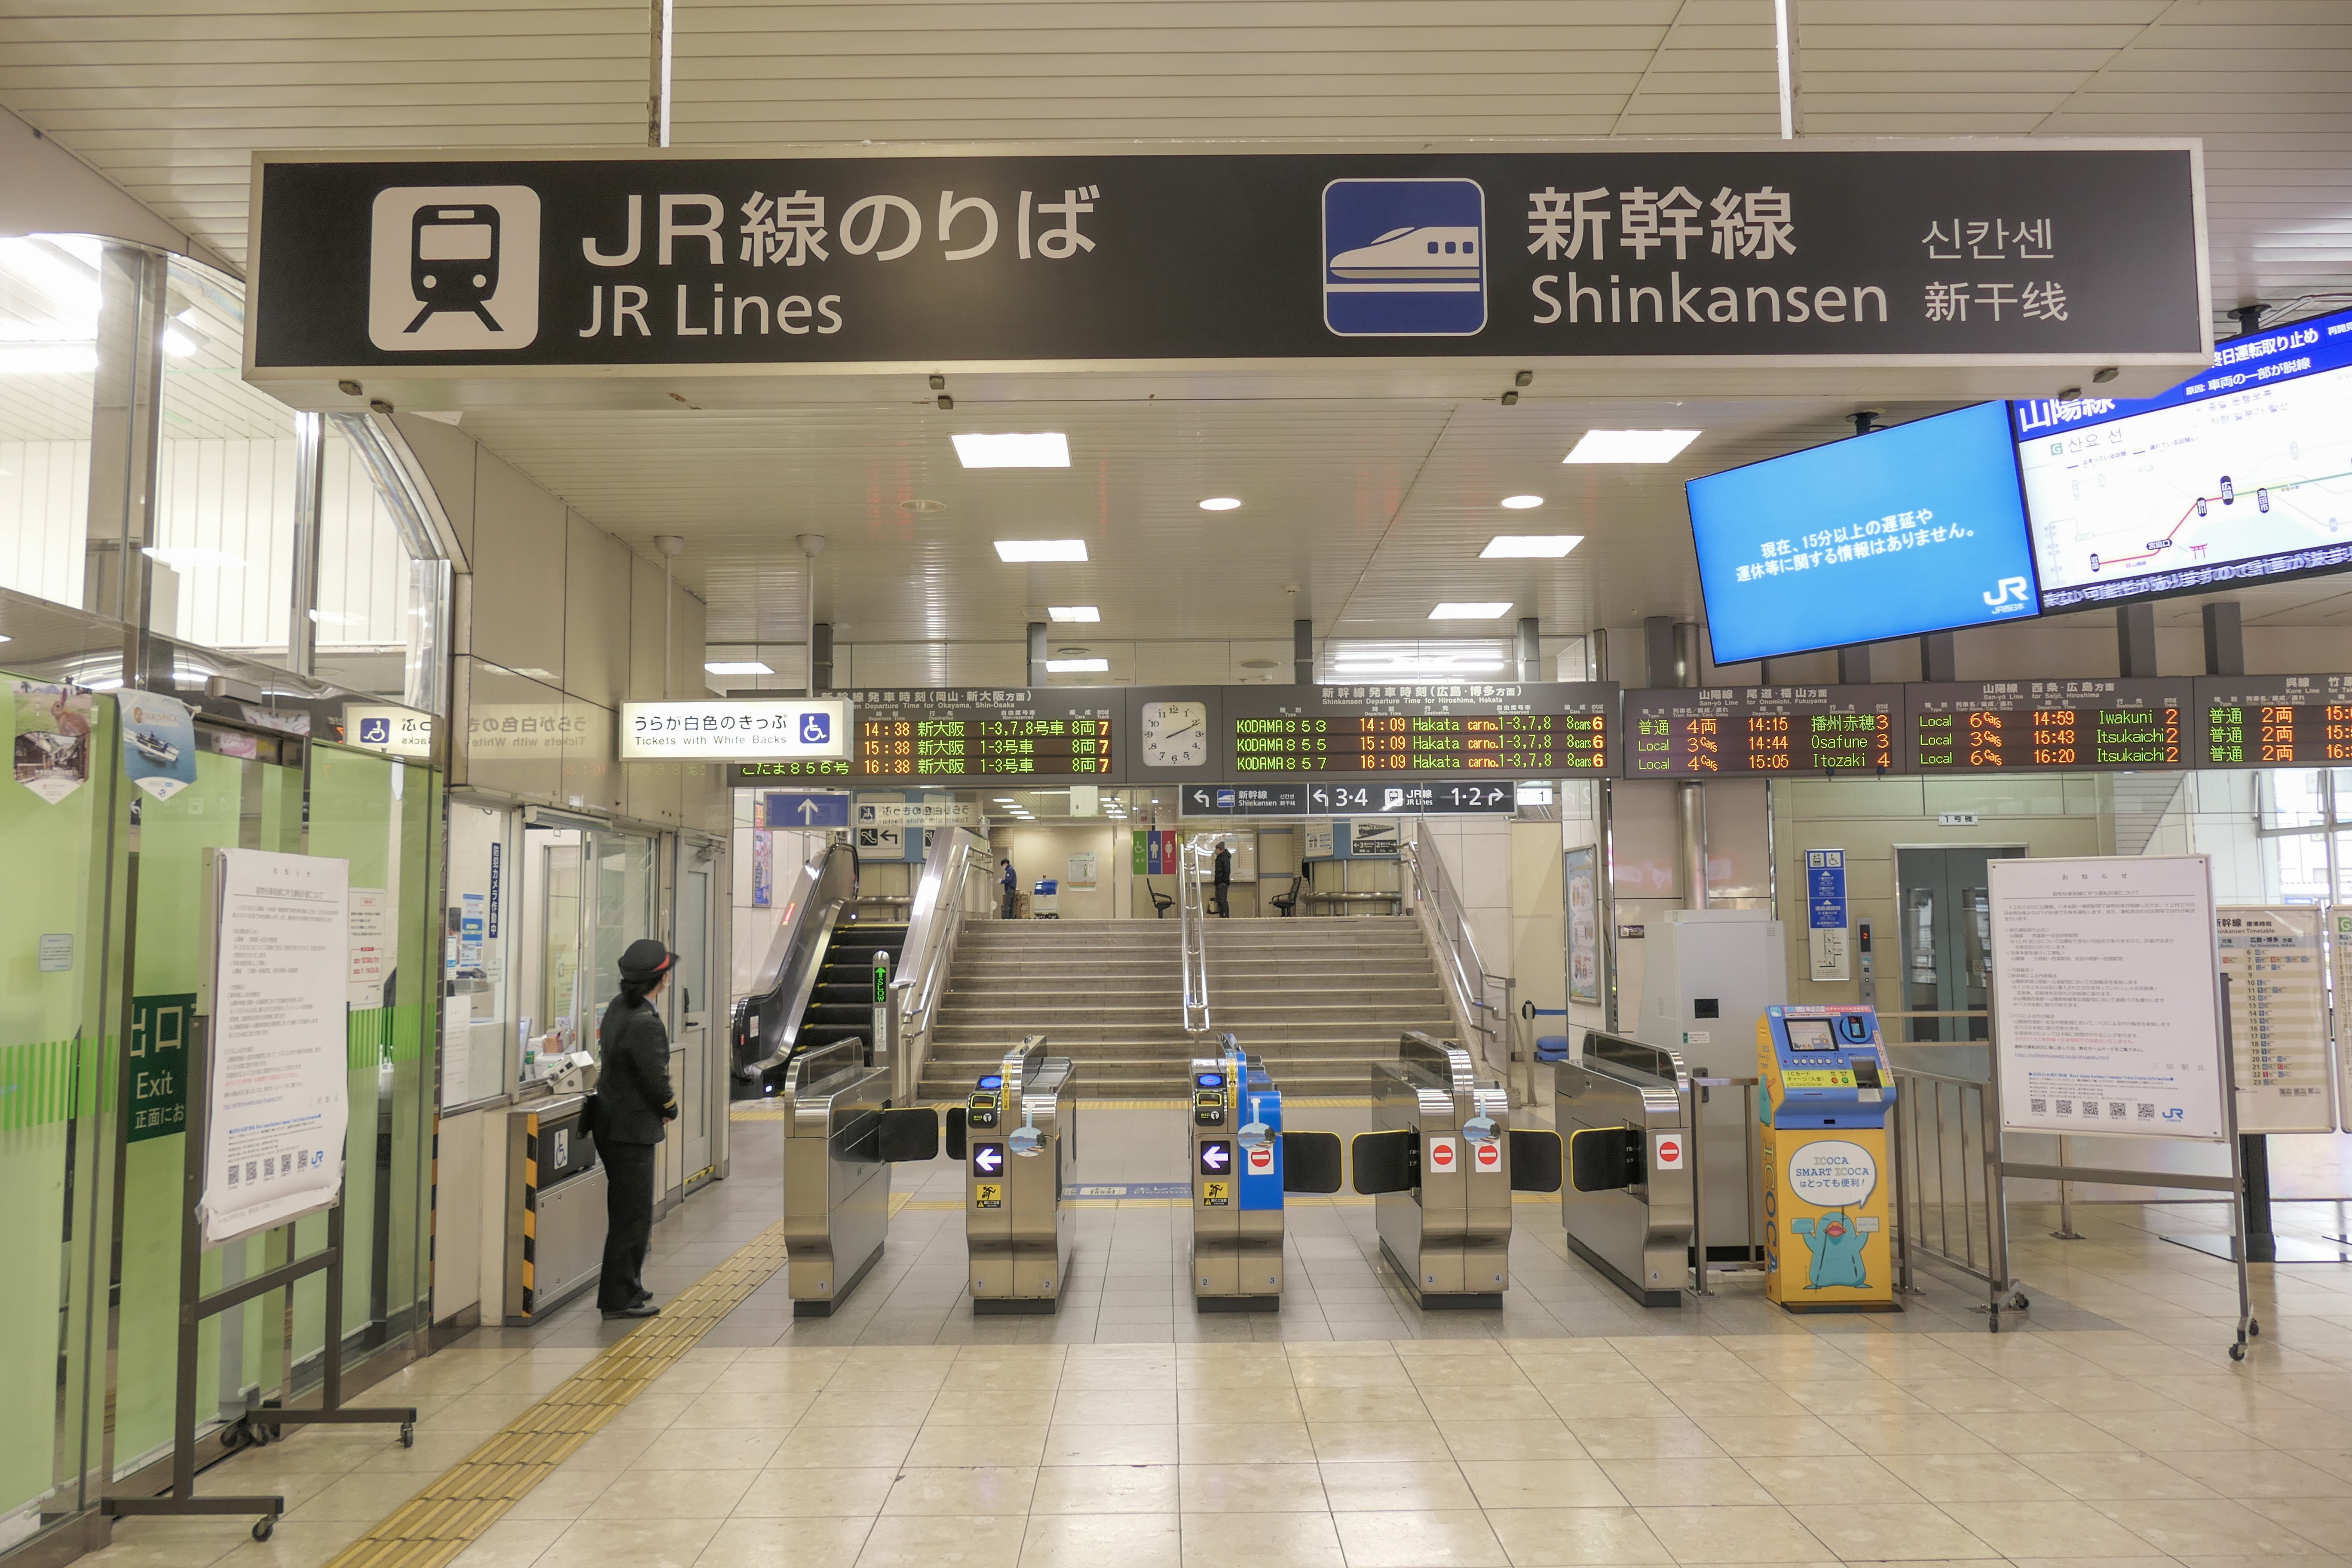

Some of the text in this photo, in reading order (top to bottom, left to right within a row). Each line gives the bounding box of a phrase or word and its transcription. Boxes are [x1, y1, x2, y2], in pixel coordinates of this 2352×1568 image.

[582, 185, 1100, 268] JR線のりば
[1527, 187, 1797, 261] 新幹線
[1922, 216, 2055, 260] 신칸센
[1532, 272, 1888, 323] Shinkansen
[1923, 279, 2069, 323] 新干线
[580, 282, 842, 337] JR Lines
[2208, 357, 2311, 391] 車両の一部が脱線
[1736, 522, 1974, 582] 運休等に関する情報はありません。
[1983, 576, 2029, 606] JR
[1699, 689, 1733, 700] 山陽線
[1983, 683, 2018, 694] 山陽線
[635, 714, 787, 731] うらが白色のきっぷ
[1920, 709, 2178, 727] Local 14:59 Iwakuni 2
[2209, 706, 2294, 724] 普通 2両
[864, 722, 910, 737] 14:38
[918, 721, 965, 737] 新大阪
[1072, 720, 1096, 736] 8両
[1099, 721, 1109, 736] 7
[1237, 720, 1283, 733] KODAMA
[1360, 717, 1406, 732] 14:09
[1413, 717, 1460, 731] Hakata
[1592, 716, 1603, 730] 6
[1638, 714, 1889, 735] 普通 4両 14:15 播州赤穂 3
[635, 735, 786, 746] Tickets with White Backs
[1237, 738, 1283, 751] KODAMA
[1360, 736, 1406, 750] 15:09
[1413, 735, 1460, 750] Hakata
[1592, 734, 1603, 749] 6
[1638, 733, 1889, 751] Local 14:44 Osafune 3
[1920, 728, 2178, 745] Local 15:43 Itsukaichi 2
[2209, 725, 2294, 743] 普通 2両
[865, 738, 1109, 756] 15:38 新大阪 1-3号車 8両 7
[1920, 746, 2179, 764] Local 16:20 Itsukaichi 2
[865, 757, 1109, 774] 16:38 新大阪 1-3号車 8両 7
[1237, 757, 1283, 770] KODAMA
[1361, 755, 1406, 769] 16:09
[1413, 754, 1461, 769] Hakata
[1593, 753, 1604, 768] 6
[1638, 752, 1890, 770] Local 15:05 Itozaki 4
[1238, 790, 1268, 799] 新幹線
[1406, 789, 1432, 799] JR線
[137, 1070, 173, 1099] Exit
[2162, 1108, 2184, 1119] JR
[1813, 1157, 1849, 1165] ICOCA
[1796, 1167, 1869, 1176] SMART ICOCA
